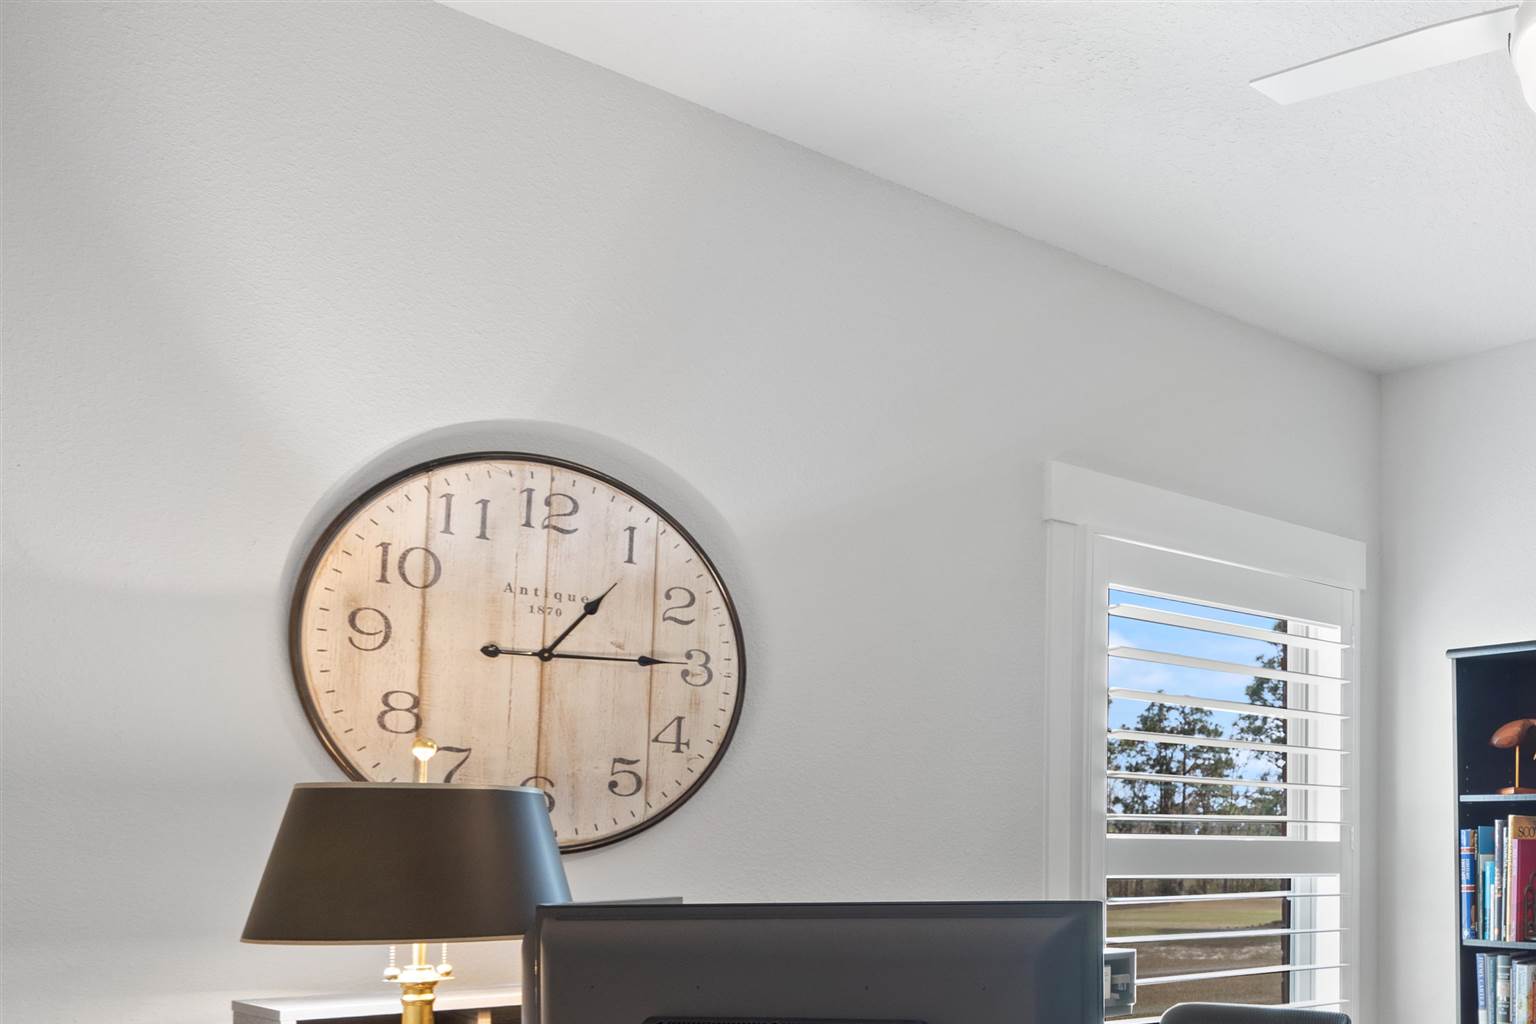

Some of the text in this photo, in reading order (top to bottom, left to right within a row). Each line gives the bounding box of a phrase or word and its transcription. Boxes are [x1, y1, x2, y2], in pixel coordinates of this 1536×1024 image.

[440, 493, 491, 541] 11
[519, 488, 580, 536] 12
[623, 526, 638, 565] 1
[375, 542, 442, 590] 10
[504, 581, 591, 604] Antique
[528, 606, 562, 618] 1870
[662, 586, 696, 626] 2
[348, 608, 392, 652] 9
[680, 648, 714, 687] 3
[376, 690, 422, 734] 8
[651, 716, 691, 754] 4
[607, 757, 644, 797] 5
